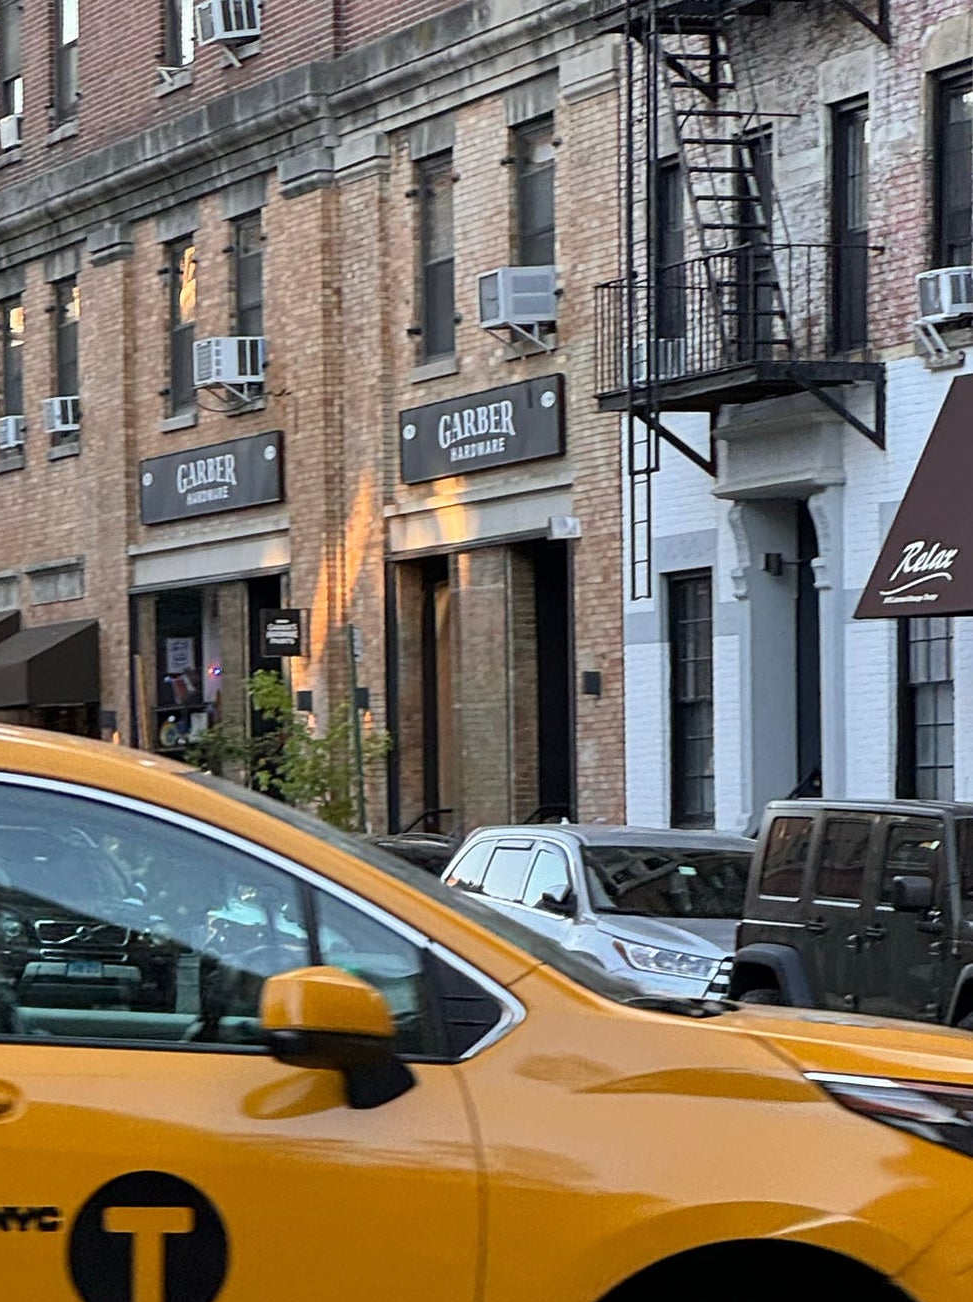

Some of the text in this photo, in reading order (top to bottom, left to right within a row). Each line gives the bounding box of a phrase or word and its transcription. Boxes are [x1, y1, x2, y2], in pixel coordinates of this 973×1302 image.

[438, 400, 516, 449] GARBER
[450, 437, 506, 462] HARDWARE
[177, 453, 238, 494] GARBER
[889, 540, 959, 582] Relax
